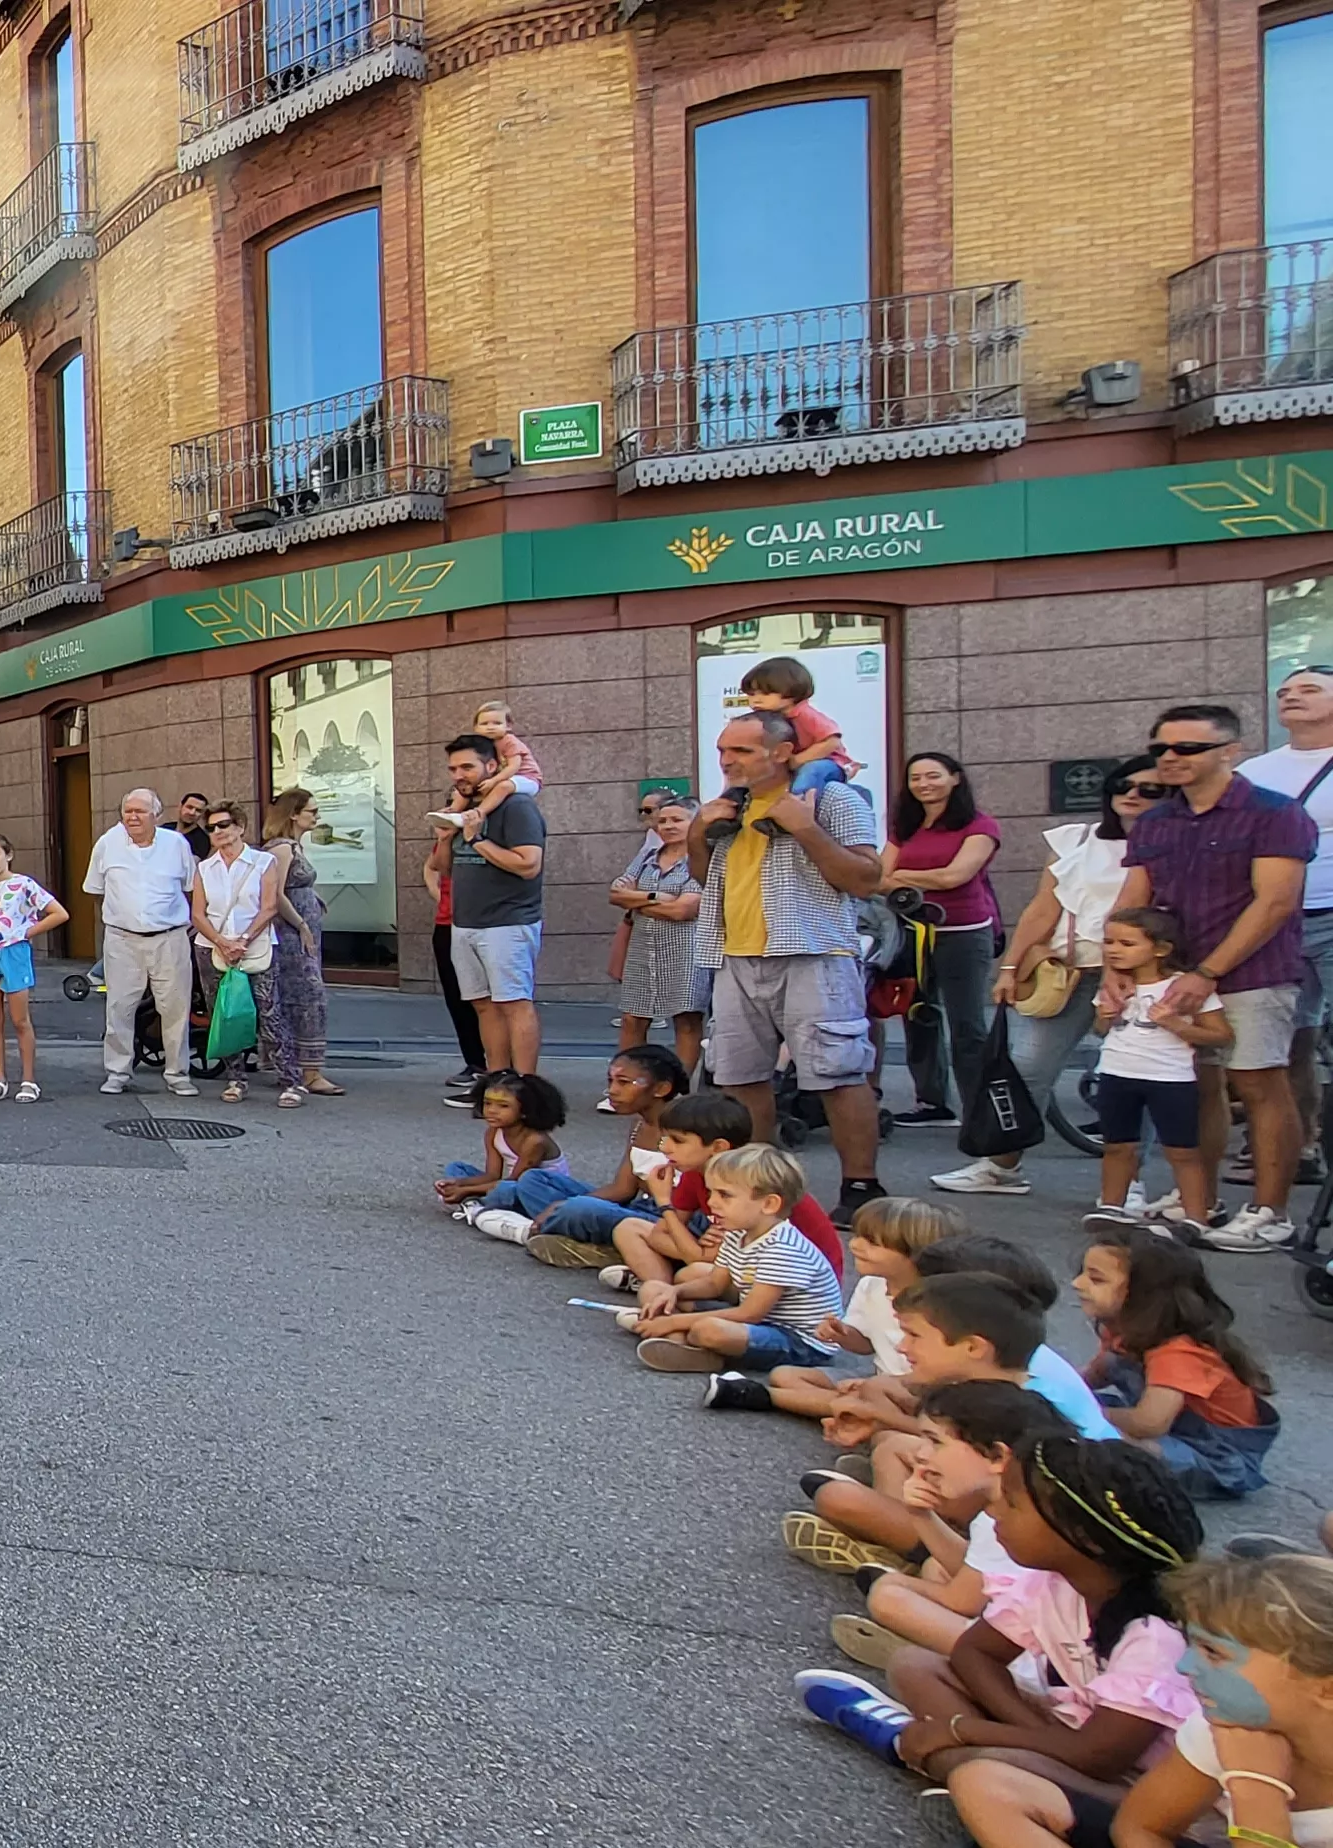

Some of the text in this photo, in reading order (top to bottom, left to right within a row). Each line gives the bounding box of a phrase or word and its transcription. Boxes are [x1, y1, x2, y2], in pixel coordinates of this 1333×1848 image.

[540, 429, 585, 441] NAVARRA
[547, 420, 578, 431] PLAZA
[745, 509, 945, 547] CAJA RURAL
[767, 538, 923, 568] DE ARAGÓN
[39, 639, 85, 664] CAJA RURAL
